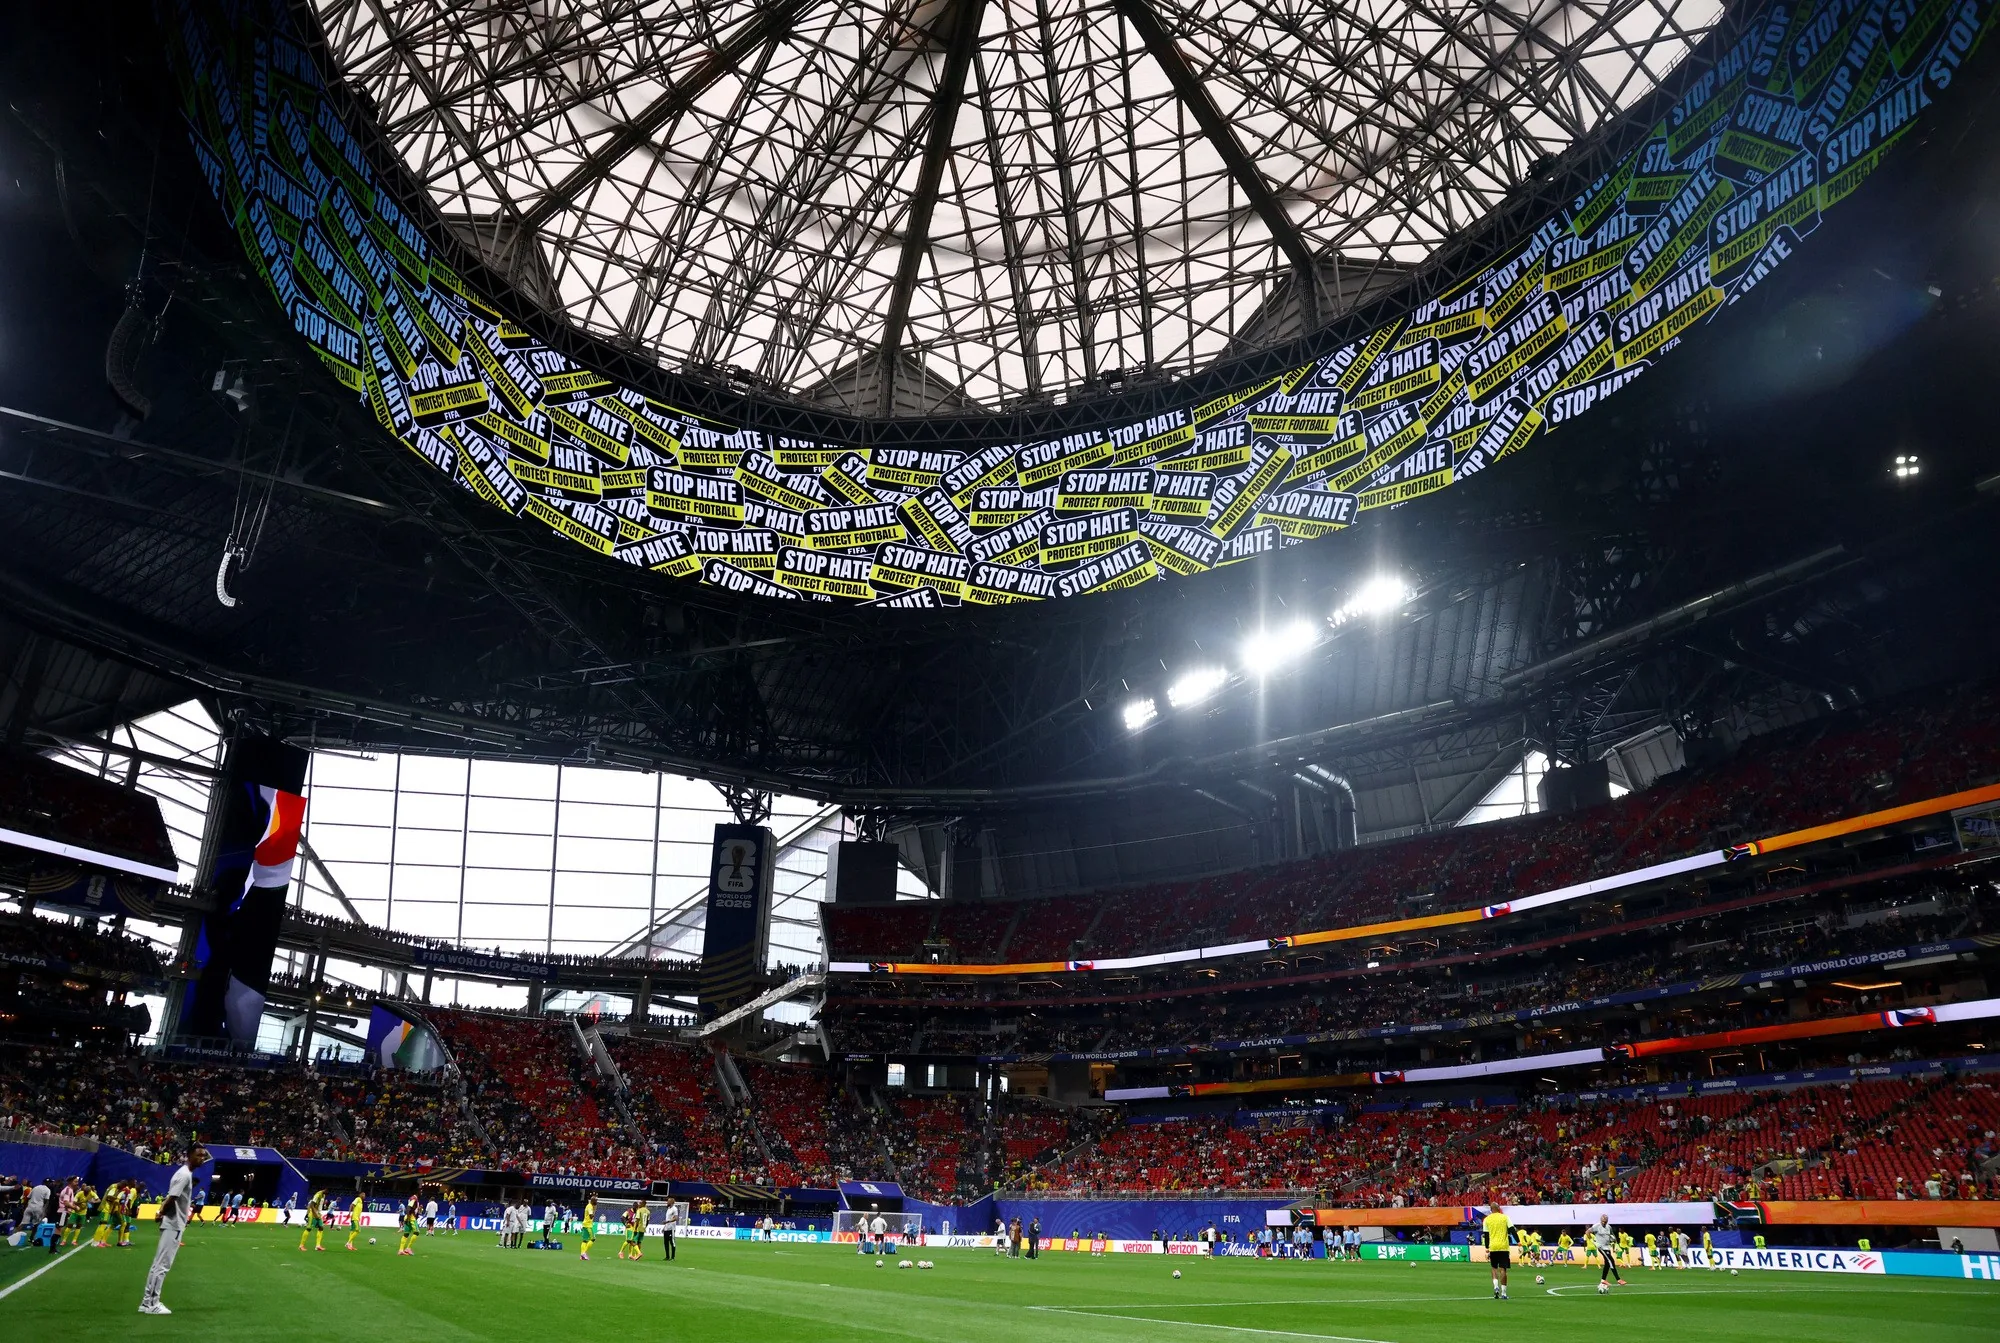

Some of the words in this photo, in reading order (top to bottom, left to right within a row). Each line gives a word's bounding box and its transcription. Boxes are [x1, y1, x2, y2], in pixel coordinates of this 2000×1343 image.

[1827, 112, 1875, 173] STOP
[1716, 190, 1762, 244] STOP
[1767, 155, 1813, 212] HATE
[1629, 226, 1671, 273] STOP
[1670, 164, 1717, 225] HATE
[333, 187, 360, 237] STOP
[357, 233, 388, 288] HATE
[298, 257, 325, 298] PROTECT
[304, 225, 334, 275] STOP
[333, 271, 364, 314] HATE
[431, 260, 461, 294] PROTECT
[1619, 298, 1662, 342] STOP
[1666, 257, 1709, 311] HATE
[295, 303, 326, 344] STOP
[328, 324, 358, 364] HATE
[393, 304, 424, 357] HATE
[429, 302, 462, 342] HATE
[1468, 332, 1513, 376] STOP
[1509, 297, 1555, 345] HATE
[1622, 325, 1665, 365] PROTECT
[1667, 289, 1716, 335] FOOTBALL
[383, 324, 411, 370] FOOTBALL
[421, 321, 454, 358] FOOTBALL
[1560, 317, 1606, 370] HATE
[468, 329, 493, 371] PROTECT
[493, 372, 524, 411] FOOTBALL
[475, 320, 508, 356] STOP
[503, 357, 540, 399] HATE
[1392, 342, 1433, 378] HATE
[411, 363, 440, 391] STOP
[481, 369, 494, 389] FIFA
[381, 372, 410, 428] HATE
[415, 392, 444, 412] PROTECT
[447, 387, 481, 405] FOOTBALL
[1297, 392, 1339, 414] HATE
[444, 411, 460, 420] FIFA
[588, 406, 628, 442] HATE
[1147, 408, 1186, 437] HATE
[1252, 418, 1286, 430] PROTECT
[1288, 418, 1329, 431] FOOTBALL
[416, 431, 453, 473] HATE
[493, 434, 510, 449] FIFA
[502, 424, 542, 454] FOOTBALL
[581, 427, 621, 457] FOOTBALL
[1021, 442, 1060, 468] STOP
[1063, 431, 1103, 454] HATE
[1146, 430, 1188, 453] FOOTBALL
[1206, 425, 1245, 451] HATE
[455, 422, 491, 464] STOP
[485, 463, 524, 507] HATE
[554, 447, 593, 473] HATE
[877, 450, 917, 467] STOP
[1025, 464, 1062, 483] PROTECT
[1064, 448, 1106, 471] FOOTBALL
[1335, 457, 1375, 491] PROTECT
[1374, 427, 1419, 465] FOOTBALL
[514, 464, 550, 482] PROTECT
[552, 471, 594, 491] FOOTBALL
[654, 473, 694, 495] STOP
[696, 483, 737, 502] HATE
[739, 474, 776, 498] PROTECT
[945, 459, 984, 491] STOP
[1066, 473, 1107, 492] STOP
[1108, 472, 1149, 491] HATE
[1168, 476, 1210, 497] HATE
[545, 487, 563, 497] FIFA
[653, 495, 690, 511] PROTECT
[694, 503, 737, 518] FOOTBALL
[1062, 497, 1100, 508] PROTECT
[1102, 497, 1144, 507] FOOTBALL
[1218, 495, 1250, 532] PROTECT
[1250, 457, 1284, 496] FOOTBALL
[572, 504, 614, 536] HATE
[684, 515, 704, 524] FIFA
[810, 511, 851, 532] STOP
[854, 506, 896, 528] HATE
[908, 503, 932, 535] PROTECT
[923, 491, 958, 525] STOP
[1308, 496, 1351, 521] HATE
[527, 498, 562, 529] PROTECT
[564, 522, 605, 552] FOOTBALL
[813, 535, 851, 547] PROTECT
[854, 529, 899, 544] FOOTBALL
[972, 530, 1011, 562] STOP
[1014, 510, 1051, 541] HATE
[1046, 520, 1088, 545] STOP
[1090, 511, 1130, 537] HATE
[643, 535, 686, 565] HATE
[731, 533, 773, 552] HATE
[1047, 545, 1085, 561] PROTECT
[784, 550, 827, 574] STOP
[828, 558, 871, 580] HATE
[882, 546, 925, 572] STOP
[927, 554, 967, 578] HATE
[1059, 566, 1099, 597] STOP
[1101, 545, 1144, 579] HATE
[709, 563, 751, 592] STOP
[782, 574, 821, 590] PROTECT
[823, 582, 868, 596] FOOTBALL
[877, 569, 916, 586] PROTECT
[813, 594, 832, 602] FIFA
[715, 899, 752, 909] 2026
[0, 952, 47, 967] LANTA
[422, 952, 446, 962] FIFA
[447, 954, 487, 967] WORLD
[488, 960, 510, 970] CUP
[511, 963, 549, 975] 2026
[1791, 965, 1812, 976] FIFA
[1812, 959, 1848, 972] WORLD
[1848, 955, 1869, 968] CUP
[1870, 949, 1907, 962] 2026
[202, 1049, 228, 1057] WORLD
[1239, 1038, 1284, 1048] ATLANTA
[533, 1175, 555, 1187] FIFA
[556, 1178, 592, 1188] WORLD
[593, 1180, 613, 1189] CUP
[679, 1227, 722, 1238] AMERICA
[1223, 1215, 1241, 1223] FIFA
[751, 1228, 817, 1242] Hsense
[948, 1236, 975, 1247] Dove
[1123, 1242, 1152, 1252] verizon
[1168, 1243, 1198, 1254] verizon
[1712, 1251, 1734, 1266] OF
[1742, 1252, 1847, 1270] AMERICA
